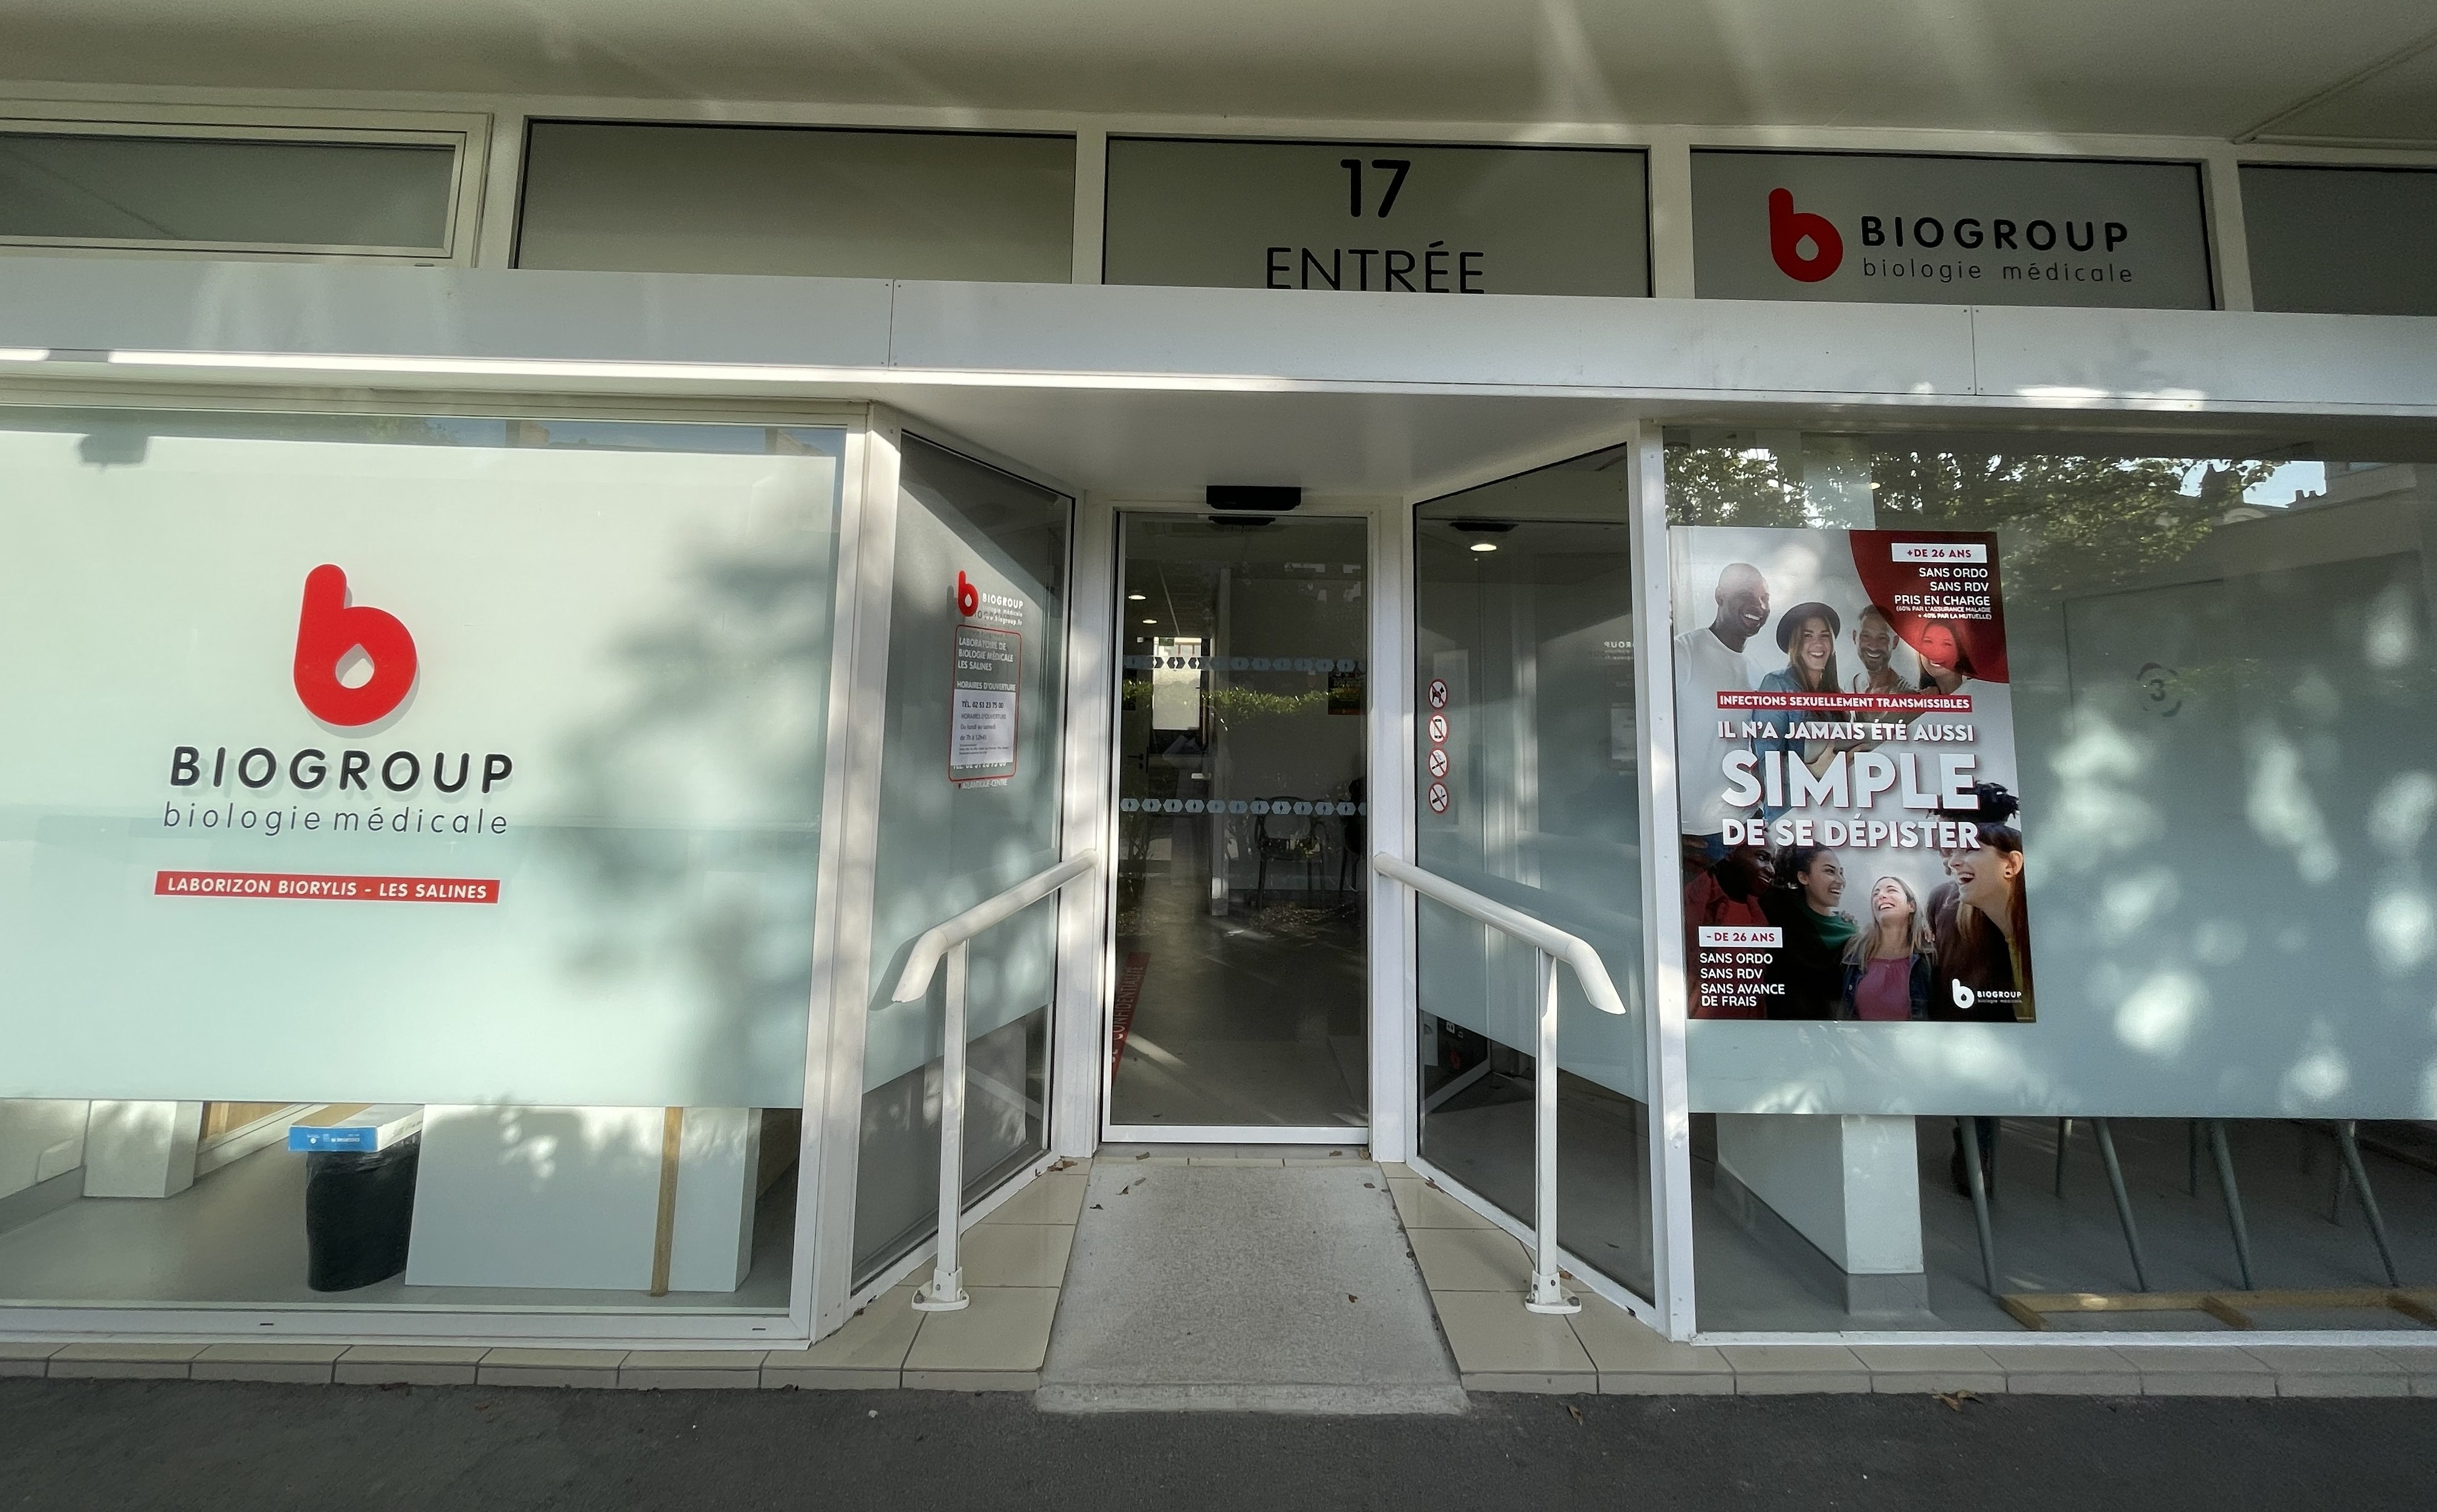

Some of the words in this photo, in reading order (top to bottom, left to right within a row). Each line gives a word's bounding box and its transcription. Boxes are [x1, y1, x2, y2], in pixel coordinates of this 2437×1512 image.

[1340, 158, 1411, 219] 17
[1860, 215, 2128, 253] BIOGROUP
[1266, 240, 1485, 294] ENTRÉE
[1863, 257, 1982, 283] biologie
[2002, 261, 2133, 283] médicale
[1931, 549, 1945, 558] 26
[1949, 549, 1972, 558] ANS
[1918, 567, 1950, 578] SANS
[1953, 568, 1989, 578] ORDO
[1930, 581, 1961, 592] SANS
[1964, 582, 1989, 592] RDV
[982, 592, 1024, 609] BIOGROUP
[1894, 595, 1921, 605] PRIS
[1924, 595, 1940, 606] EN
[1943, 596, 1991, 606] CHARGE
[959, 637, 998, 650] LABORATOIRE
[998, 642, 1006, 651] DE
[958, 648, 986, 660] BIOLOGIE
[986, 651, 1014, 663] MÉDICALE
[957, 660, 968, 670] LES
[969, 661, 992, 671] SALINES
[957, 680, 983, 690] HORAIRES
[1720, 694, 1787, 707] INFECTIONS
[1789, 696, 1874, 708] SEXUELLEMENT
[1876, 697, 1970, 709] TRANSMISSIBLES
[1717, 720, 1736, 738] IL
[1742, 721, 1779, 739] N'A
[1784, 722, 1866, 741] JAMAIS
[1872, 719, 1908, 741] ÉTÉ
[1914, 724, 1975, 742] AUSSI
[170, 745, 513, 794] BIOGROUP
[1721, 749, 1979, 810] SIMPLE
[163, 800, 321, 836] biologie
[334, 806, 507, 835] médicale
[1722, 818, 1765, 847] DE
[1775, 819, 1814, 847] SE
[1824, 813, 1981, 849] DÉPISTER
[167, 877, 271, 894] LABORIZON
[277, 880, 357, 896] BIORYLIS
[378, 882, 409, 897] LES
[415, 884, 487, 899] SALINES
[1714, 932, 1729, 942] DE
[1732, 932, 1747, 942] 26
[1750, 932, 1775, 942] ANS
[1700, 952, 1733, 964] SANS
[1736, 953, 1773, 964] ORDO
[1700, 968, 1733, 979] SANS
[1736, 968, 1763, 979] RDV
[1701, 983, 1734, 994] SANS
[1737, 983, 1785, 995] AVANCE
[1976, 990, 2022, 999] BIOGROUP
[1701, 995, 1718, 1006] DE
[1721, 995, 1757, 1007] FRAIS
